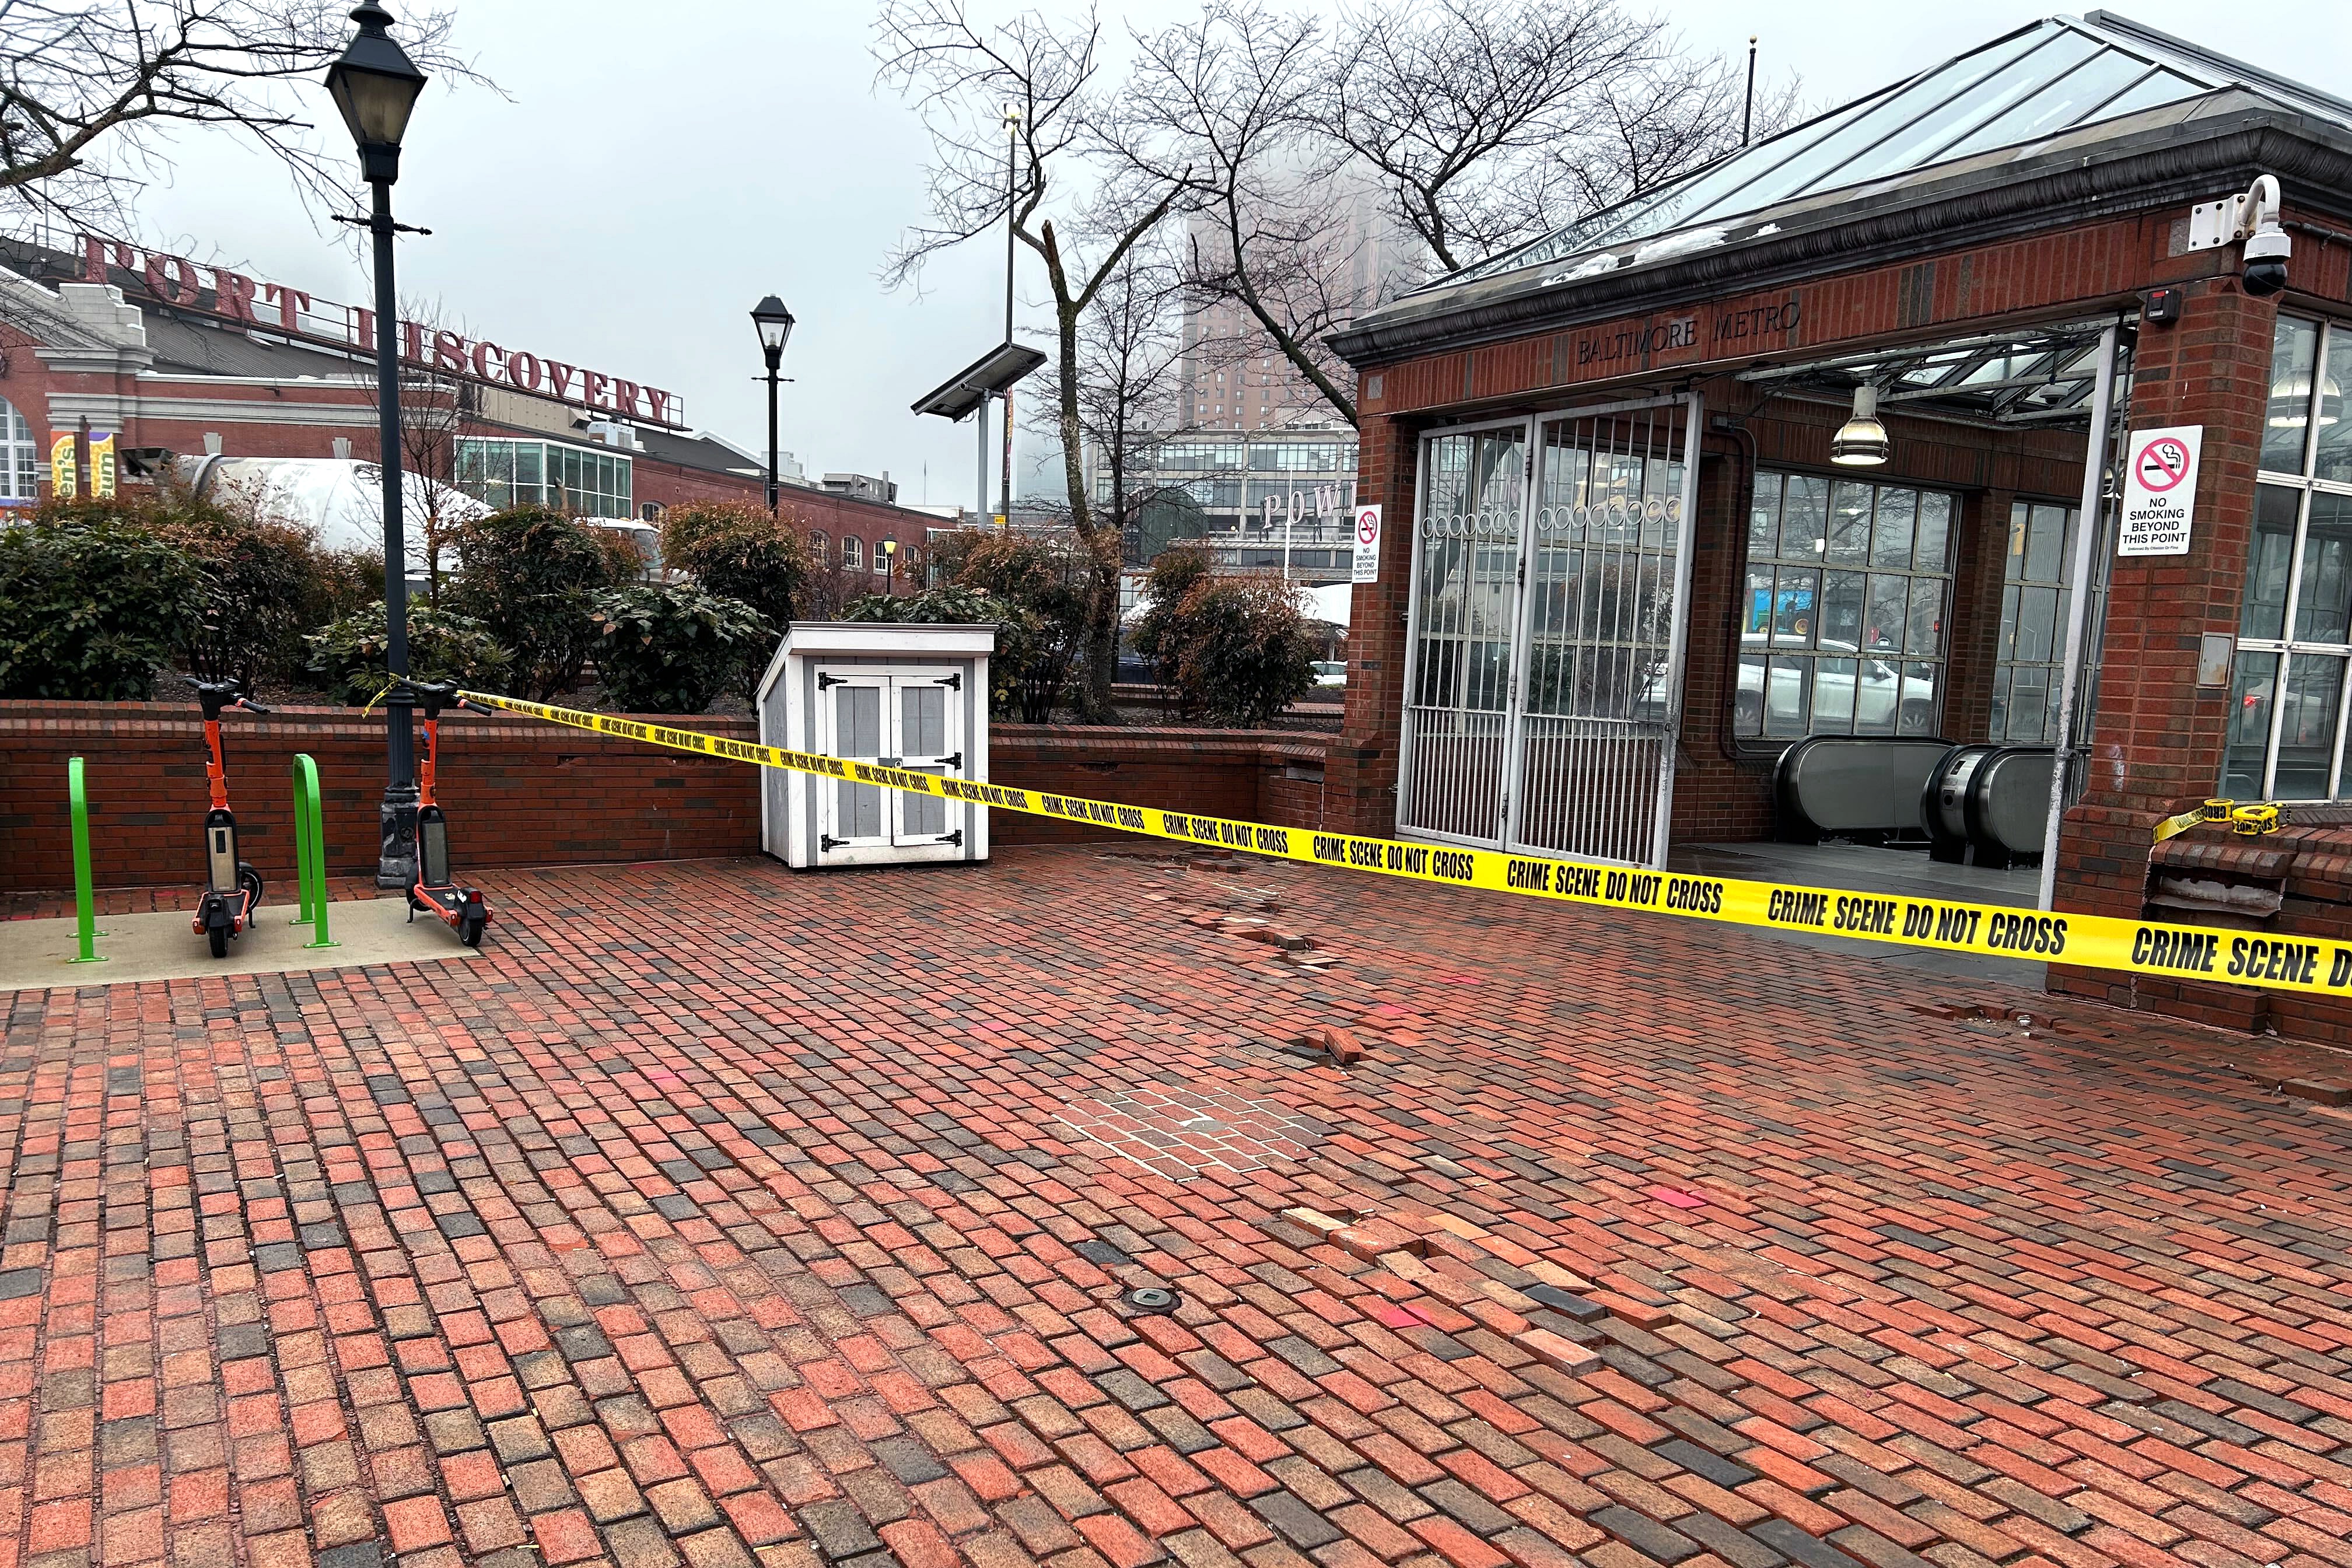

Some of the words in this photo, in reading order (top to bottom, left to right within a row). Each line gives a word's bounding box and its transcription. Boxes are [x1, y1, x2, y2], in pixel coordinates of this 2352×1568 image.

[83, 234, 310, 332] PORT
[1578, 320, 1697, 364] BALTIMORE
[1714, 302, 1801, 342] METRO
[2129, 509, 2185, 520] SMOKING
[2149, 498, 2166, 508] NO
[2123, 534, 2148, 544] THIS
[2151, 533, 2187, 543] POINT
[2132, 522, 2179, 532] BEYOND
[780, 751, 794, 767] CRIME
[794, 754, 811, 771] SCENE
[810, 757, 818, 772] DO
[817, 758, 828, 774] NOT
[828, 760, 845, 776] CROSS
[855, 764, 873, 782] CRIME
[872, 766, 891, 785] SCENE
[889, 770, 898, 786] DO
[897, 772, 910, 789] NOT
[909, 774, 930, 792] CROSS
[940, 779, 963, 797] CRIME
[960, 782, 982, 801] SCENE
[981, 786, 992, 803] DO
[989, 787, 1005, 804] NOT
[1004, 789, 1028, 809] CROSS
[1041, 794, 1063, 814] CRIME
[1065, 798, 1090, 819] SCENE
[1088, 802, 1100, 820] DO
[1100, 804, 1117, 824] NOT
[1117, 807, 1145, 830] CROSS
[1163, 813, 1191, 836] CRIME
[1191, 817, 1220, 842] SCENE
[1221, 822, 1234, 845] DO
[1234, 824, 1253, 848] NOT
[1256, 828, 1289, 853] CROSS
[1313, 835, 1346, 862] CRIME
[1350, 840, 1383, 868] SCENE
[1387, 845, 1401, 871] DO
[1405, 848, 1429, 874] NOT
[1433, 850, 1474, 881] CROSS
[1507, 859, 1550, 891] CRIME
[1555, 865, 1601, 898] SCENE
[1605, 871, 1627, 901] DO
[1629, 874, 1662, 905] NOT
[1666, 878, 1723, 914] CROSS
[1768, 889, 1829, 926] CRIME
[1834, 896, 1897, 934] SCENE
[1902, 904, 1934, 940] DO
[1935, 908, 1982, 944] NOT
[1987, 912, 2067, 955] CROSS
[2132, 928, 2218, 972] CRIME
[2227, 937, 2319, 984] SCENE
[2328, 948, 2352, 988] D
